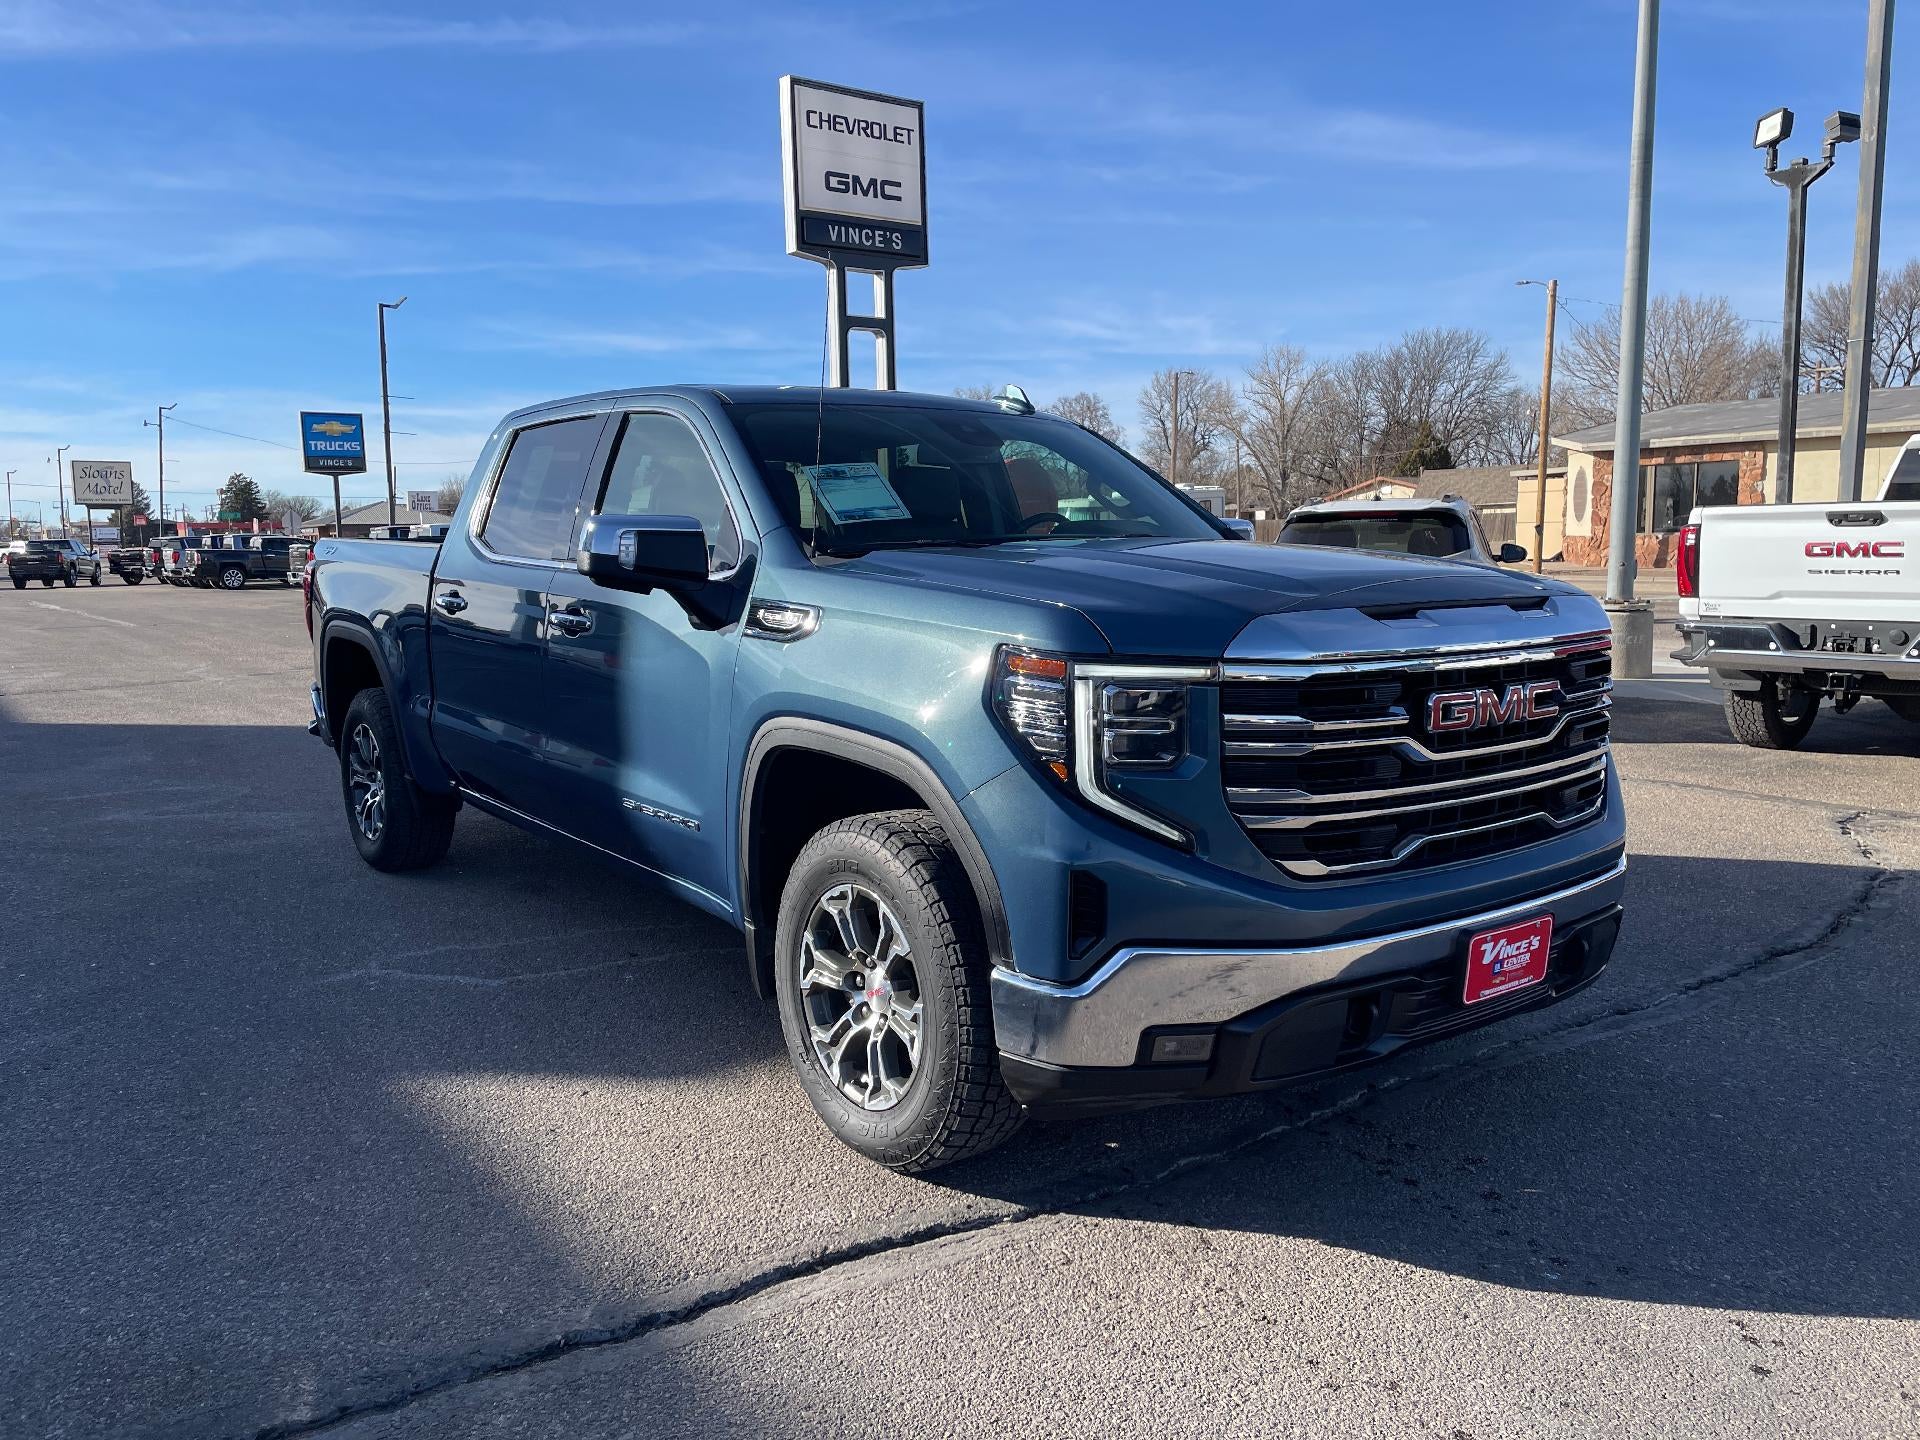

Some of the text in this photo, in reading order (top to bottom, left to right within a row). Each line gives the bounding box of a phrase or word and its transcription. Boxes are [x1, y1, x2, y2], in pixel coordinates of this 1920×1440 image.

[806, 109, 914, 145] CHEVROLET
[824, 170, 902, 201] GMC
[828, 224, 902, 250] VINCE'S
[309, 440, 361, 451] TRUCKS
[319, 459, 353, 467] VINCE'S
[82, 480, 124, 495] Motel
[1804, 541, 1905, 558] GMC
[1427, 680, 1560, 733] GMC
[1480, 936, 1541, 965] VINCE'S
